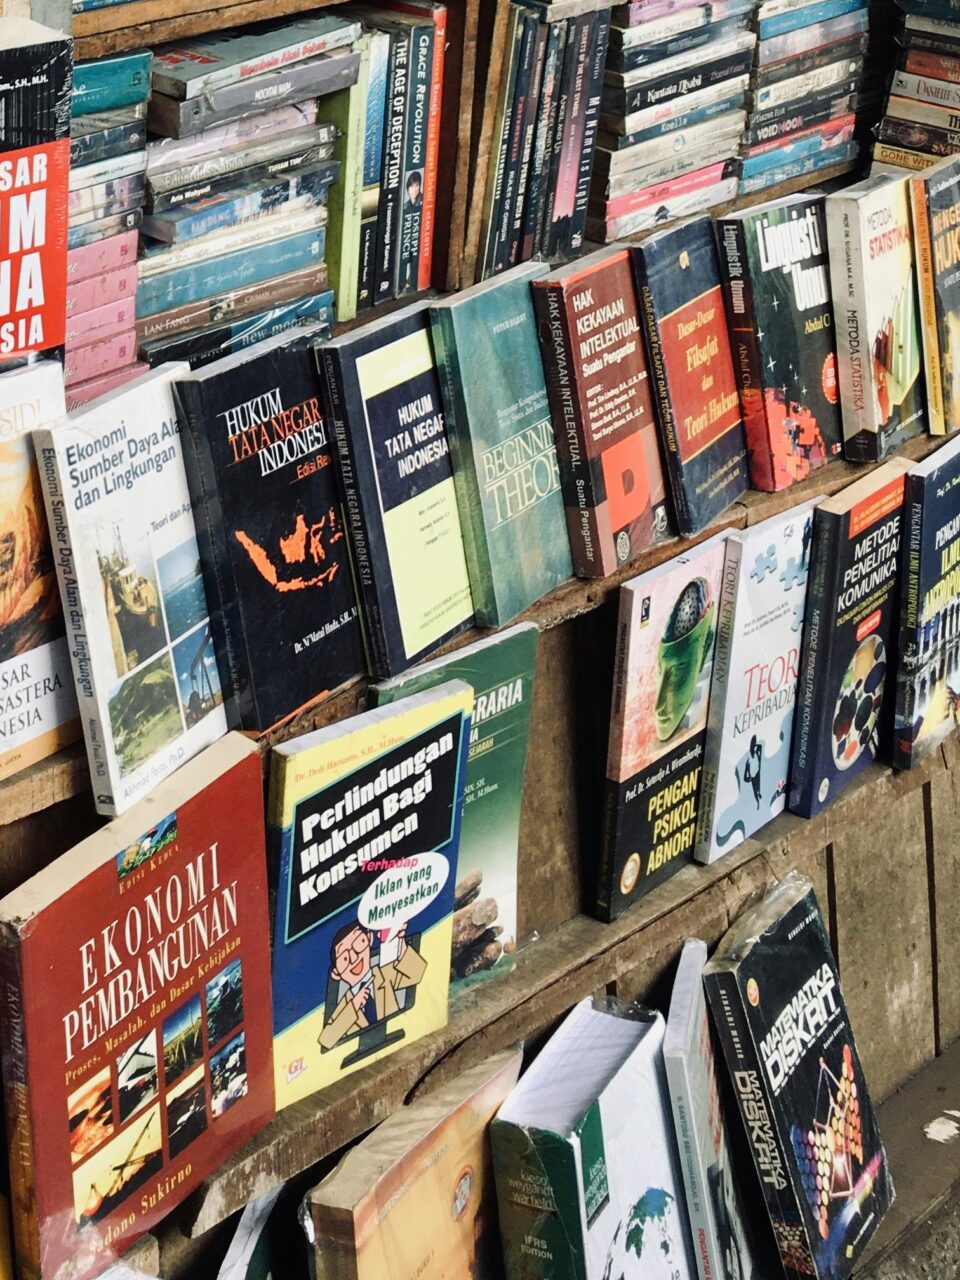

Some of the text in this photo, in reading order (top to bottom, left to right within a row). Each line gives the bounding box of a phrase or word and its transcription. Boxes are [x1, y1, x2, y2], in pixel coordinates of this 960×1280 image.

[31, 74, 49, 88] M.H.
[413, 36, 430, 164] GRACE REVOLUTION
[881, 148, 910, 163] GONE
[402, 214, 412, 259] PRINCE
[723, 225, 743, 278] Linguistik
[869, 224, 910, 260] STATISTIKA
[572, 288, 594, 311] HAK
[576, 298, 624, 336] KEKAYAAN
[580, 320, 640, 360] INTELEKTUAL
[847, 310, 864, 411] METODA STATISTIKA
[225, 388, 283, 437] HUKUM
[398, 394, 433, 426] HUKUM
[548, 292, 595, 563] HAK KEKAYAAN INTELEKTUAL, Suatu Pengantar
[684, 391, 740, 440] Teori Hukum
[65, 420, 126, 465] Ekonomi
[70, 434, 161, 487] Sumber Daya
[229, 416, 271, 464] TATA
[385, 429, 412, 458] TATA
[398, 440, 449, 478] INDONESIA
[74, 444, 176, 511] dan Lingkungan
[854, 516, 900, 561] METODE
[907, 503, 921, 629] PENGANTAR ILMU ANTROPOLOGI
[716, 558, 739, 683] TEORI KEPRIBADIAN
[800, 608, 820, 768] METODE PENELITIAN KOMUNIKASI
[302, 731, 453, 843] Perlindungan
[299, 771, 433, 876] Hukum Bagi
[298, 811, 419, 907] Konsumen
[360, 856, 419, 873] Terhadap
[374, 864, 432, 901] Iklan yang
[80, 841, 221, 995] EKONOMI
[367, 880, 440, 924] Menyesatkan
[61, 880, 239, 1065] PEMBANGUNAN
[64, 937, 242, 1087] Proses, Masalah, dan Dasar Kebijakan
[759, 963, 833, 1062] MATEMATIKA
[764, 979, 841, 1092] DISKRIT
[735, 1071, 782, 1190] DISKRIT
[747, 1071, 787, 1190] MATEMATIKA
[140, 1163, 193, 1215] Sukirno
[524, 1234, 547, 1249] IFRS
